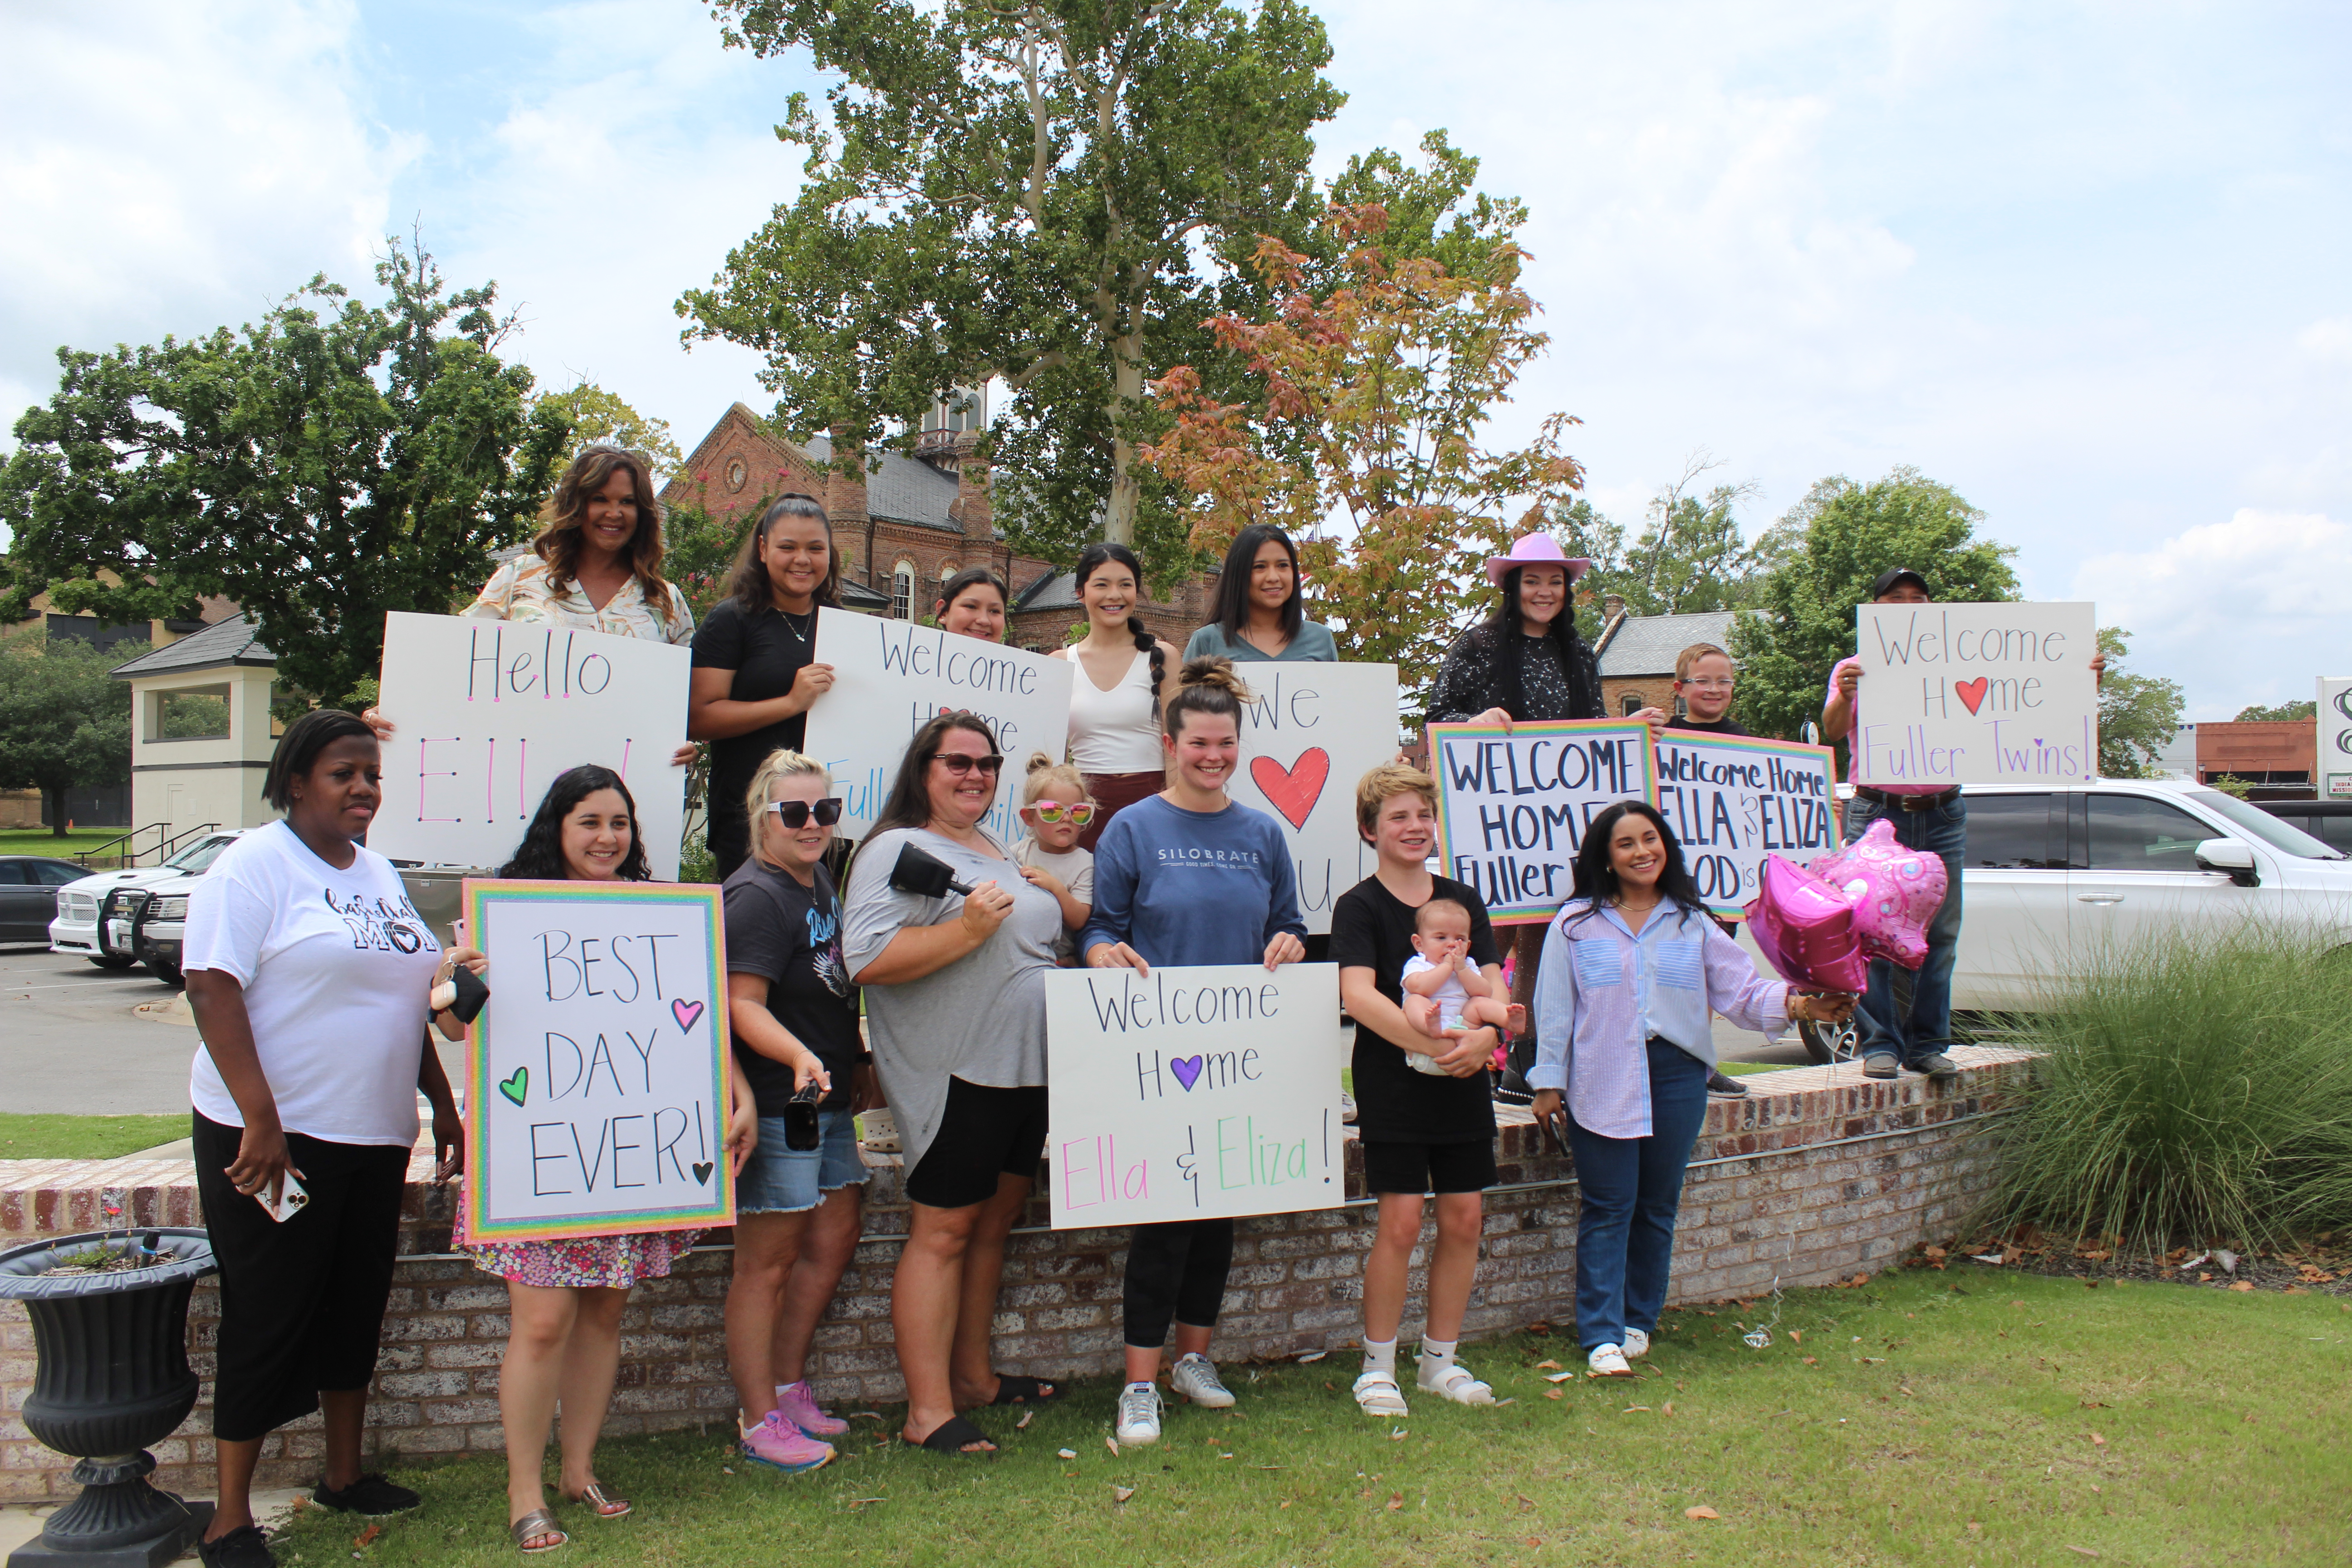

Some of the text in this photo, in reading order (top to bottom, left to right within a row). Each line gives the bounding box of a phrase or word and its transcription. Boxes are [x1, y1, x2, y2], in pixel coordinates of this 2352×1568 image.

[467, 624, 611, 703] Hello
[880, 622, 1037, 695] Welcome
[1874, 610, 2066, 666] Welcome
[1445, 739, 1642, 795] WELCOME
[1656, 745, 1766, 789] Welcome
[1865, 714, 2091, 781] Fuller Twins!
[827, 759, 893, 821] Full
[1759, 794, 1831, 850] ELIZA
[1158, 848, 1259, 864] SILOBRATE
[1455, 855, 1565, 907] Fuller
[1680, 851, 1741, 900] OD
[1741, 862, 1756, 888] is
[533, 929, 679, 1003] BEST
[1088, 971, 1279, 1033] Welcome
[545, 1028, 658, 1102] DAY
[530, 1100, 714, 1196] EVER!
[1063, 1134, 1148, 1210] Ella
